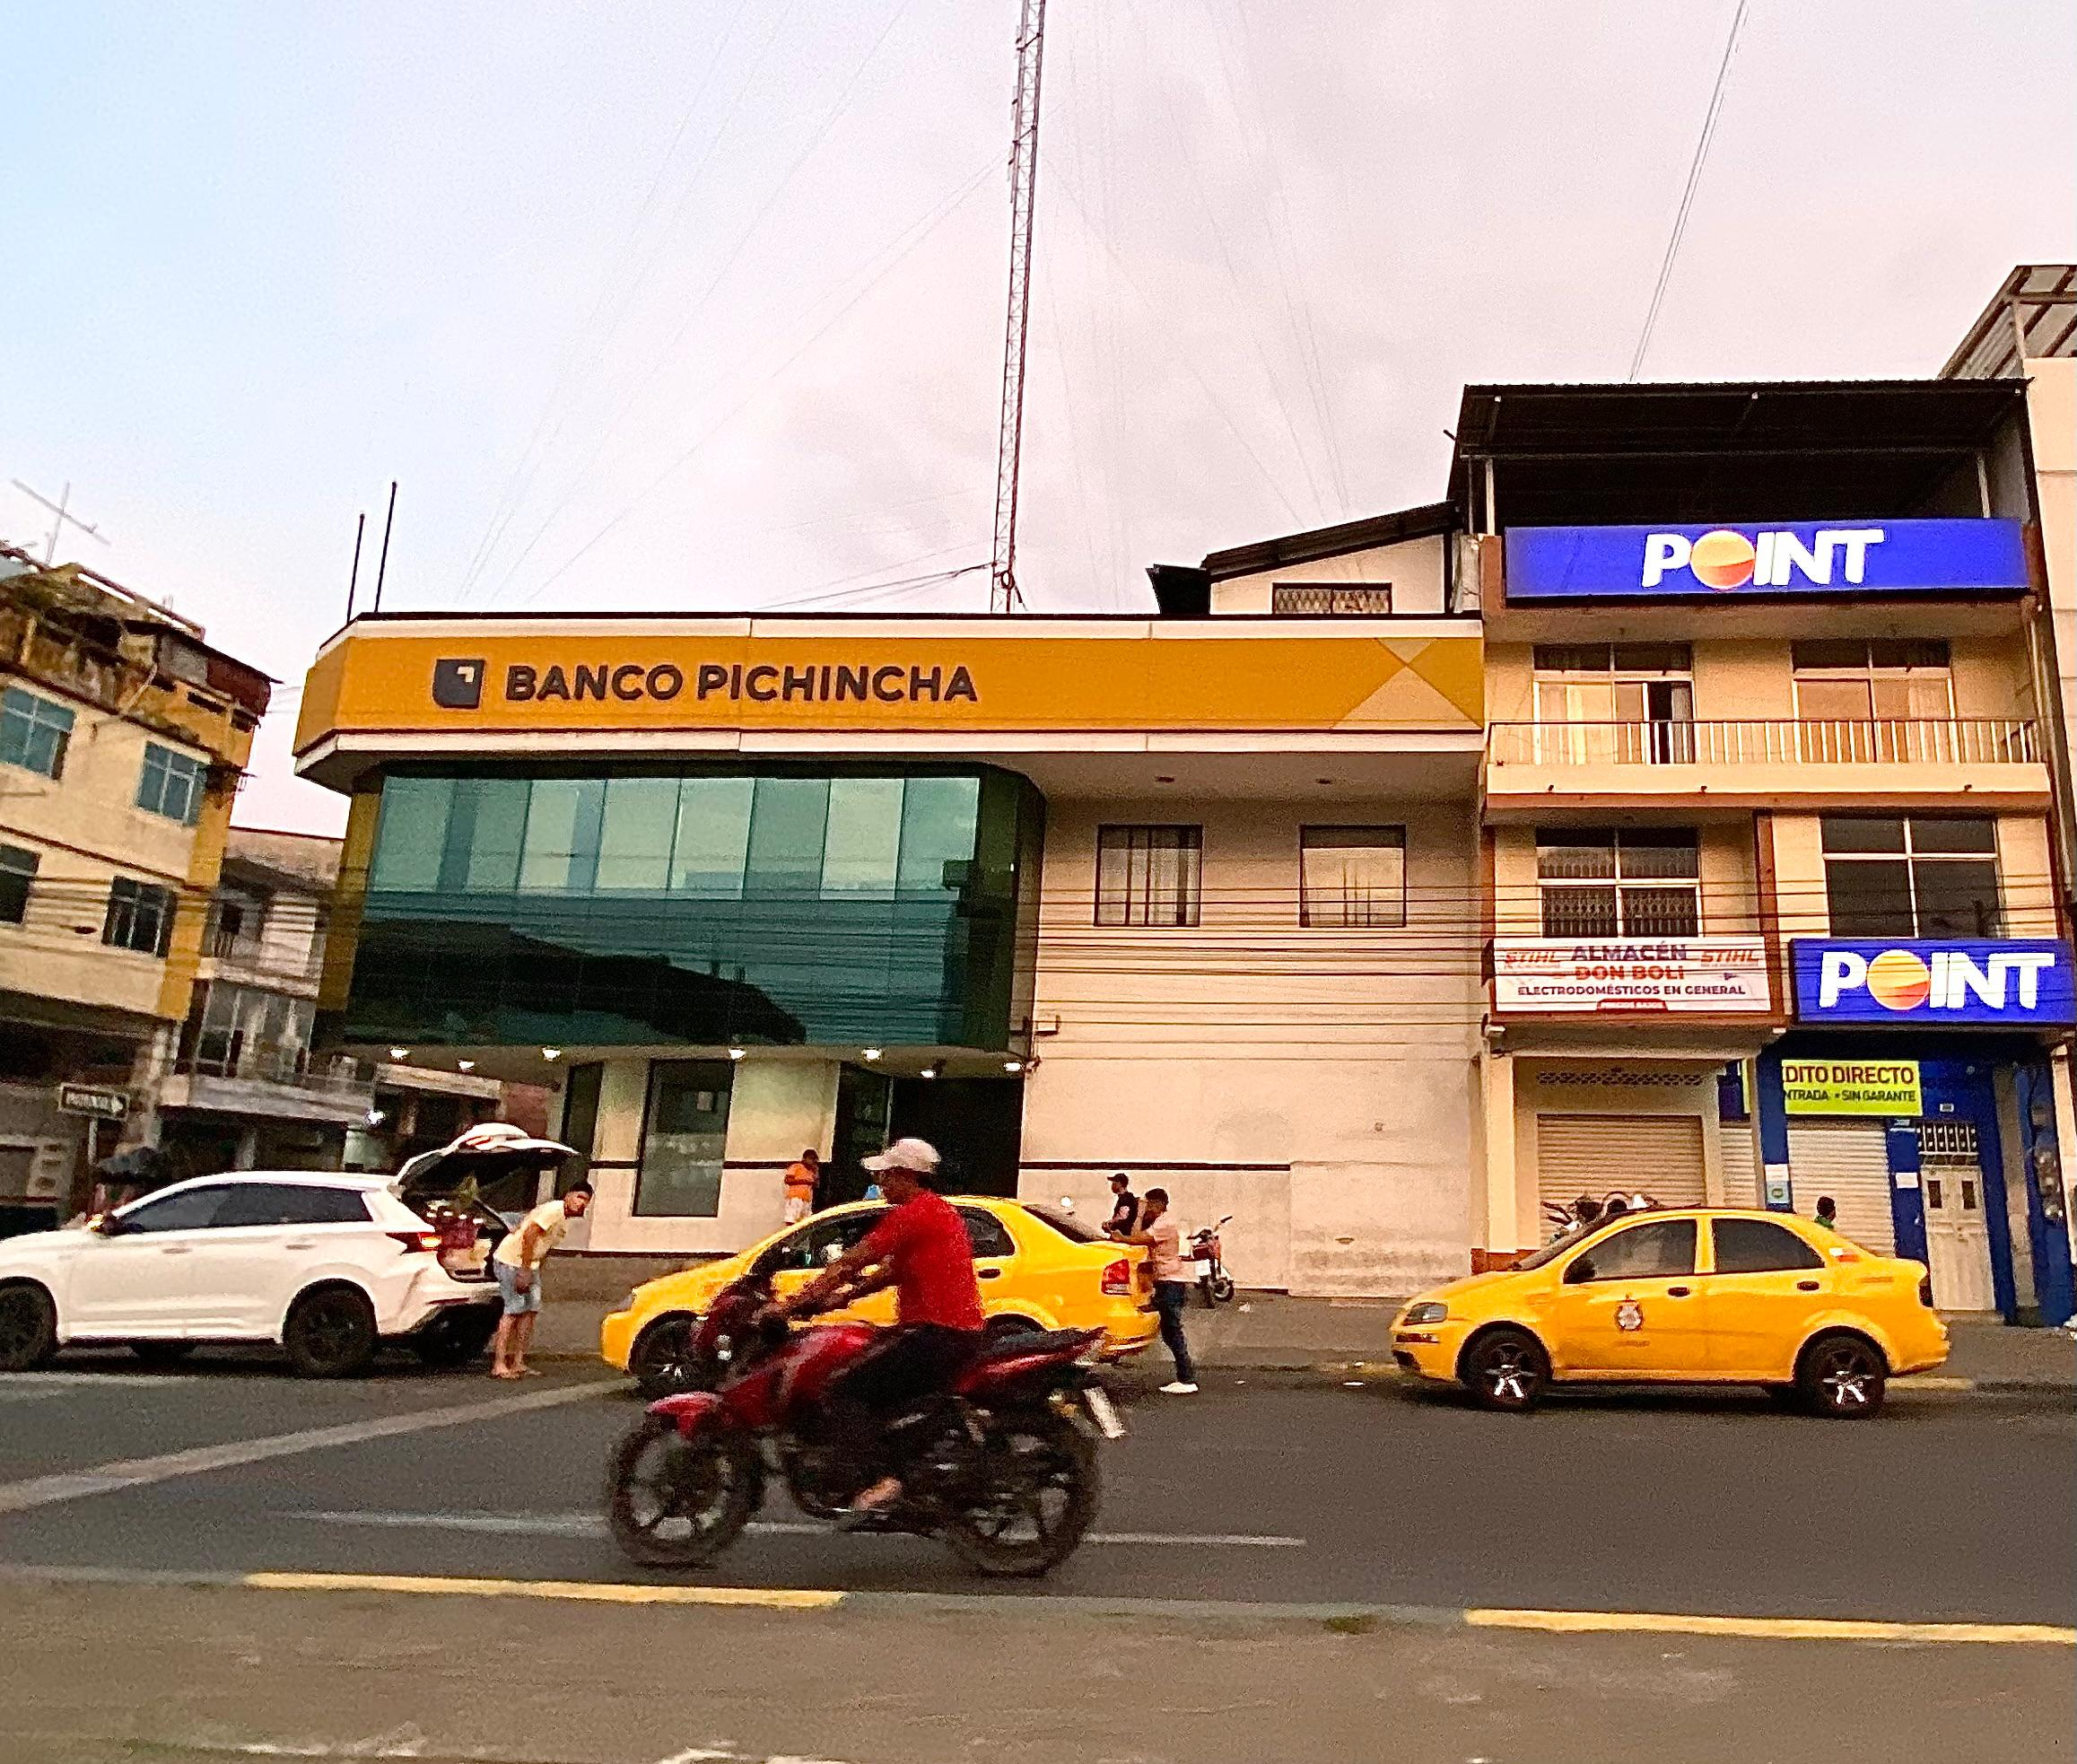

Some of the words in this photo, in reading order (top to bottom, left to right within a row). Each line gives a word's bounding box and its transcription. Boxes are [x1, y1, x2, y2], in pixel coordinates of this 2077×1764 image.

[1641, 528, 1885, 590] POINT
[506, 664, 684, 701] BANCO
[696, 664, 978, 702] PICHINCHA
[1571, 940, 1687, 961] ALMACÉN
[1700, 949, 1760, 963] STIHL
[1575, 965, 1625, 980] DON
[1631, 965, 1684, 980] BOLI
[1819, 948, 2055, 1010] POINT
[1518, 983, 1661, 995] ELECTRODOMÉSTICOS
[1663, 985, 1681, 995] EN
[1685, 985, 1746, 994] GENERAL
[1781, 1066, 1828, 1083] DITO
[1832, 1066, 1915, 1085] DIRECTO
[1842, 1089, 1861, 1101] SIN
[1863, 1090, 1916, 1102] GARANTE
